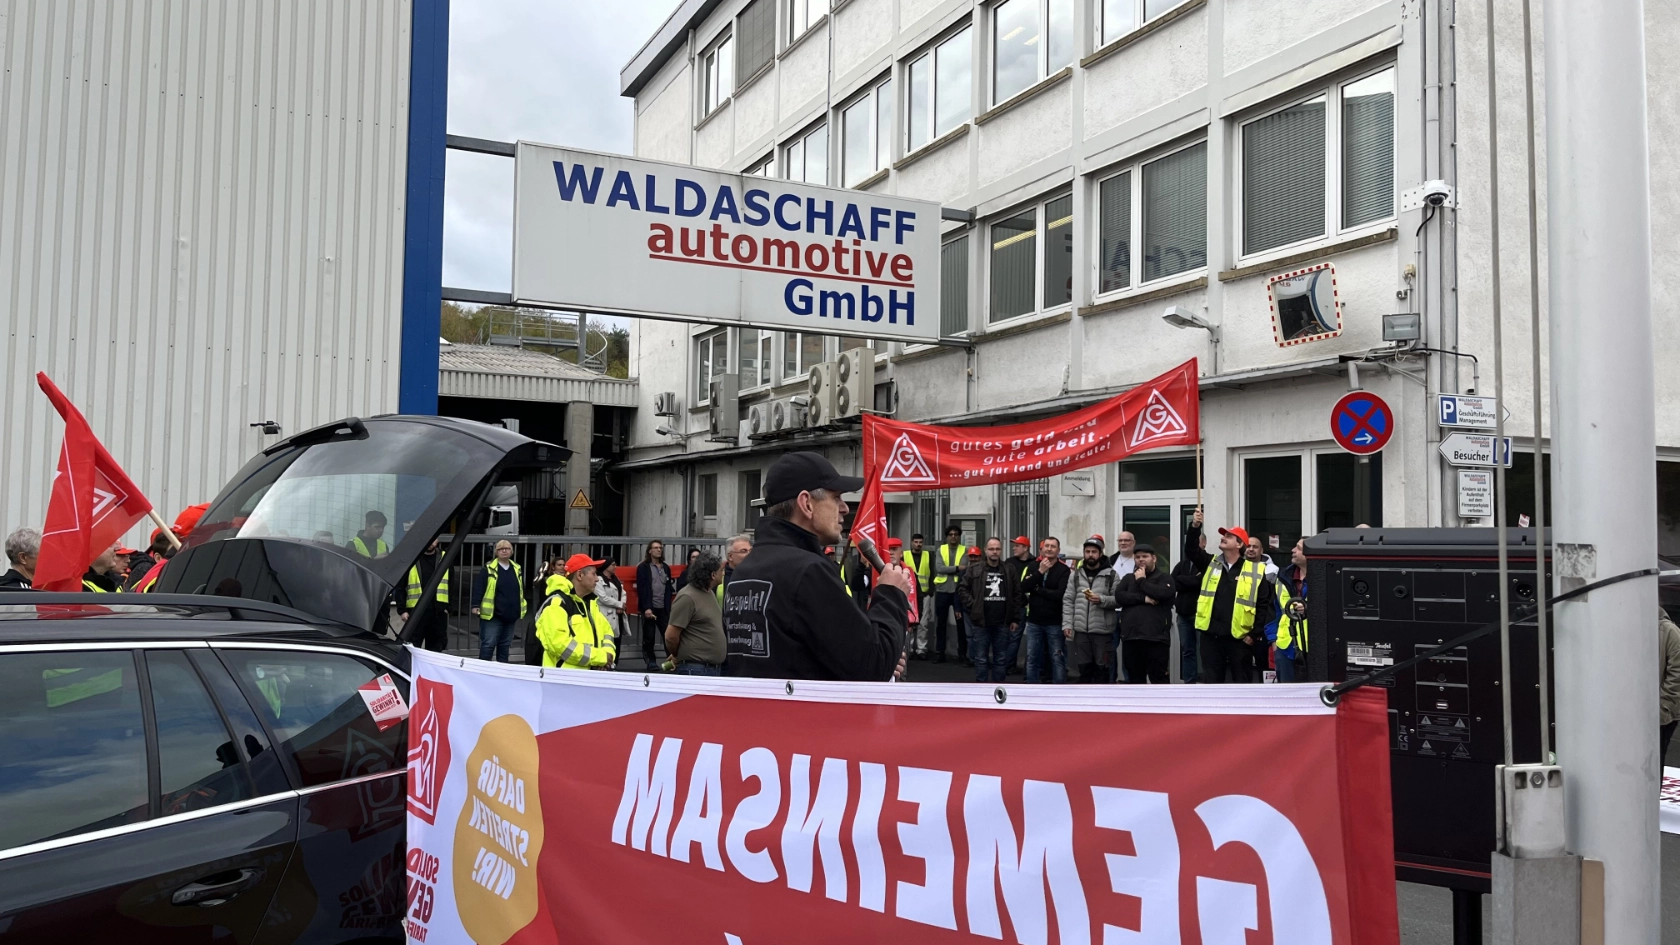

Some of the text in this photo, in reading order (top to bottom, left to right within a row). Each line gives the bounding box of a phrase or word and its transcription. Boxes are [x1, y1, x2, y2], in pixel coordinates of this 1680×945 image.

[552, 160, 916, 245] WALDASCHAFF
[647, 222, 914, 282] automotive
[784, 278, 915, 326] GmbH
[950, 440, 1003, 453] gutes
[1453, 450, 1489, 461] Besucher
[982, 451, 1026, 466] gute
[989, 466, 1009, 477] für
[1013, 461, 1042, 472] land
[1047, 456, 1070, 468] und
[1064, 475, 1091, 483] Anmeldung
